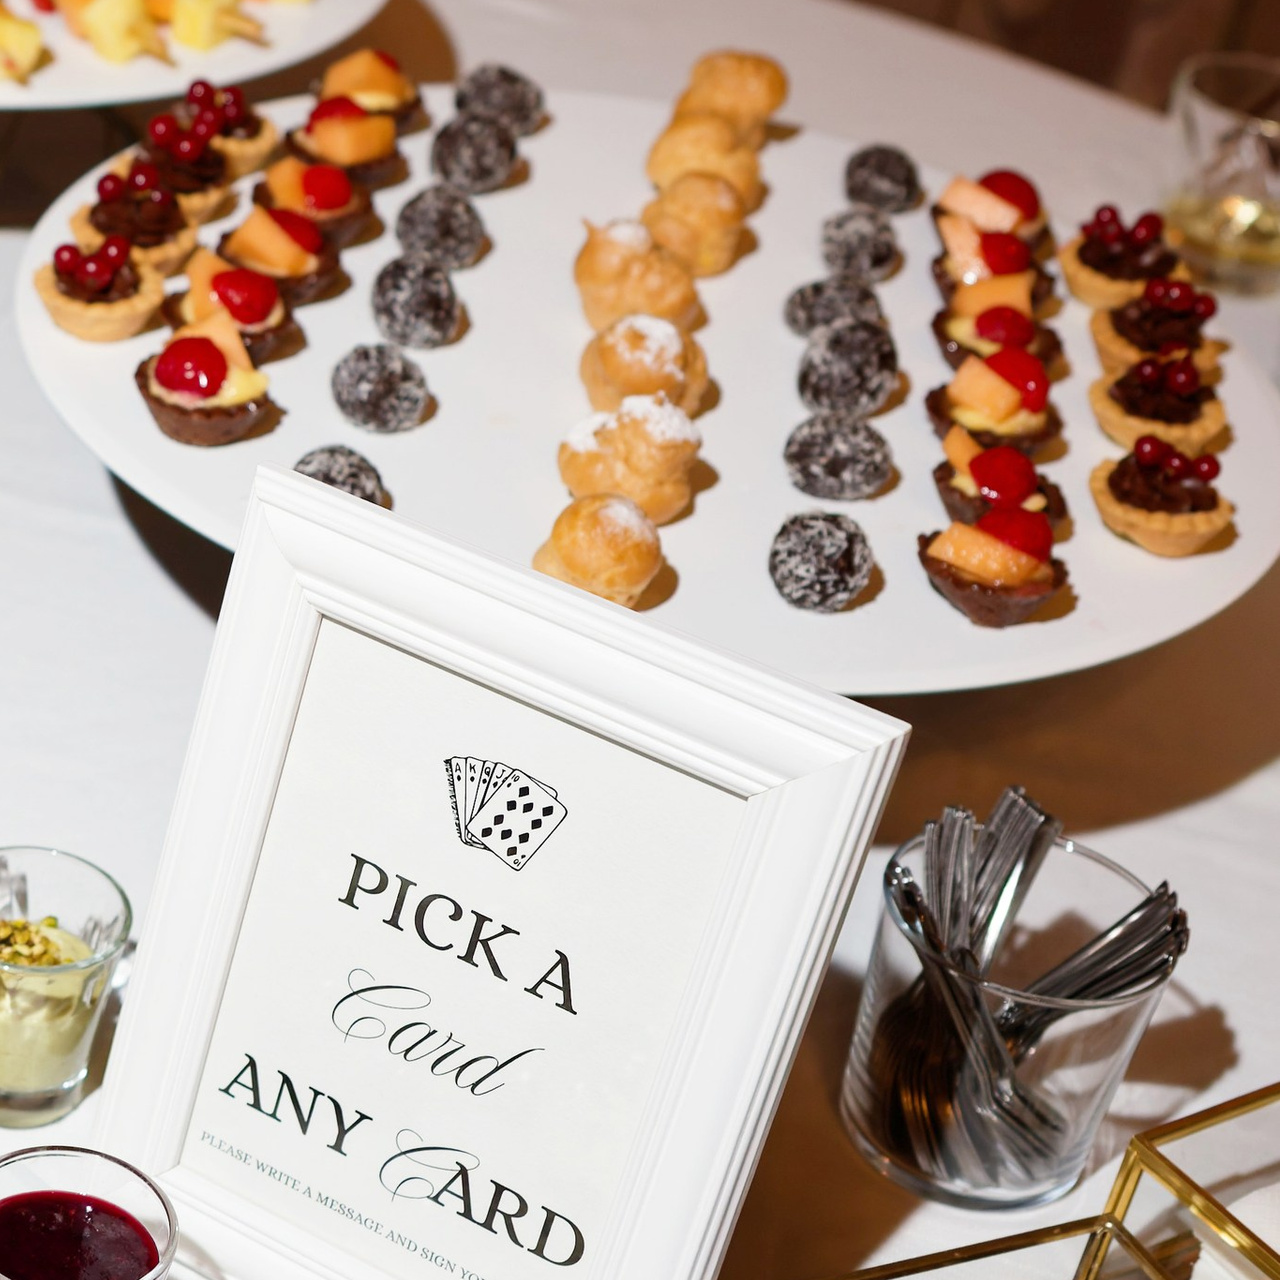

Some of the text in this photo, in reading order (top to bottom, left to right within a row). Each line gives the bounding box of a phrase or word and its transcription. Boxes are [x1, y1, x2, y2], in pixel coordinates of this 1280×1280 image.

[338, 853, 578, 1015] PICK A
[331, 968, 545, 1096] Card
[200, 1131, 253, 1166] PLEASE
[255, 1159, 301, 1191] WRITE
[303, 1187, 312, 1198] A
[316, 1192, 384, 1235] MESSAGE
[386, 1230, 418, 1253] AND
[420, 1247, 457, 1273] SIGN
[219, 1053, 585, 1268] ANY CARD
